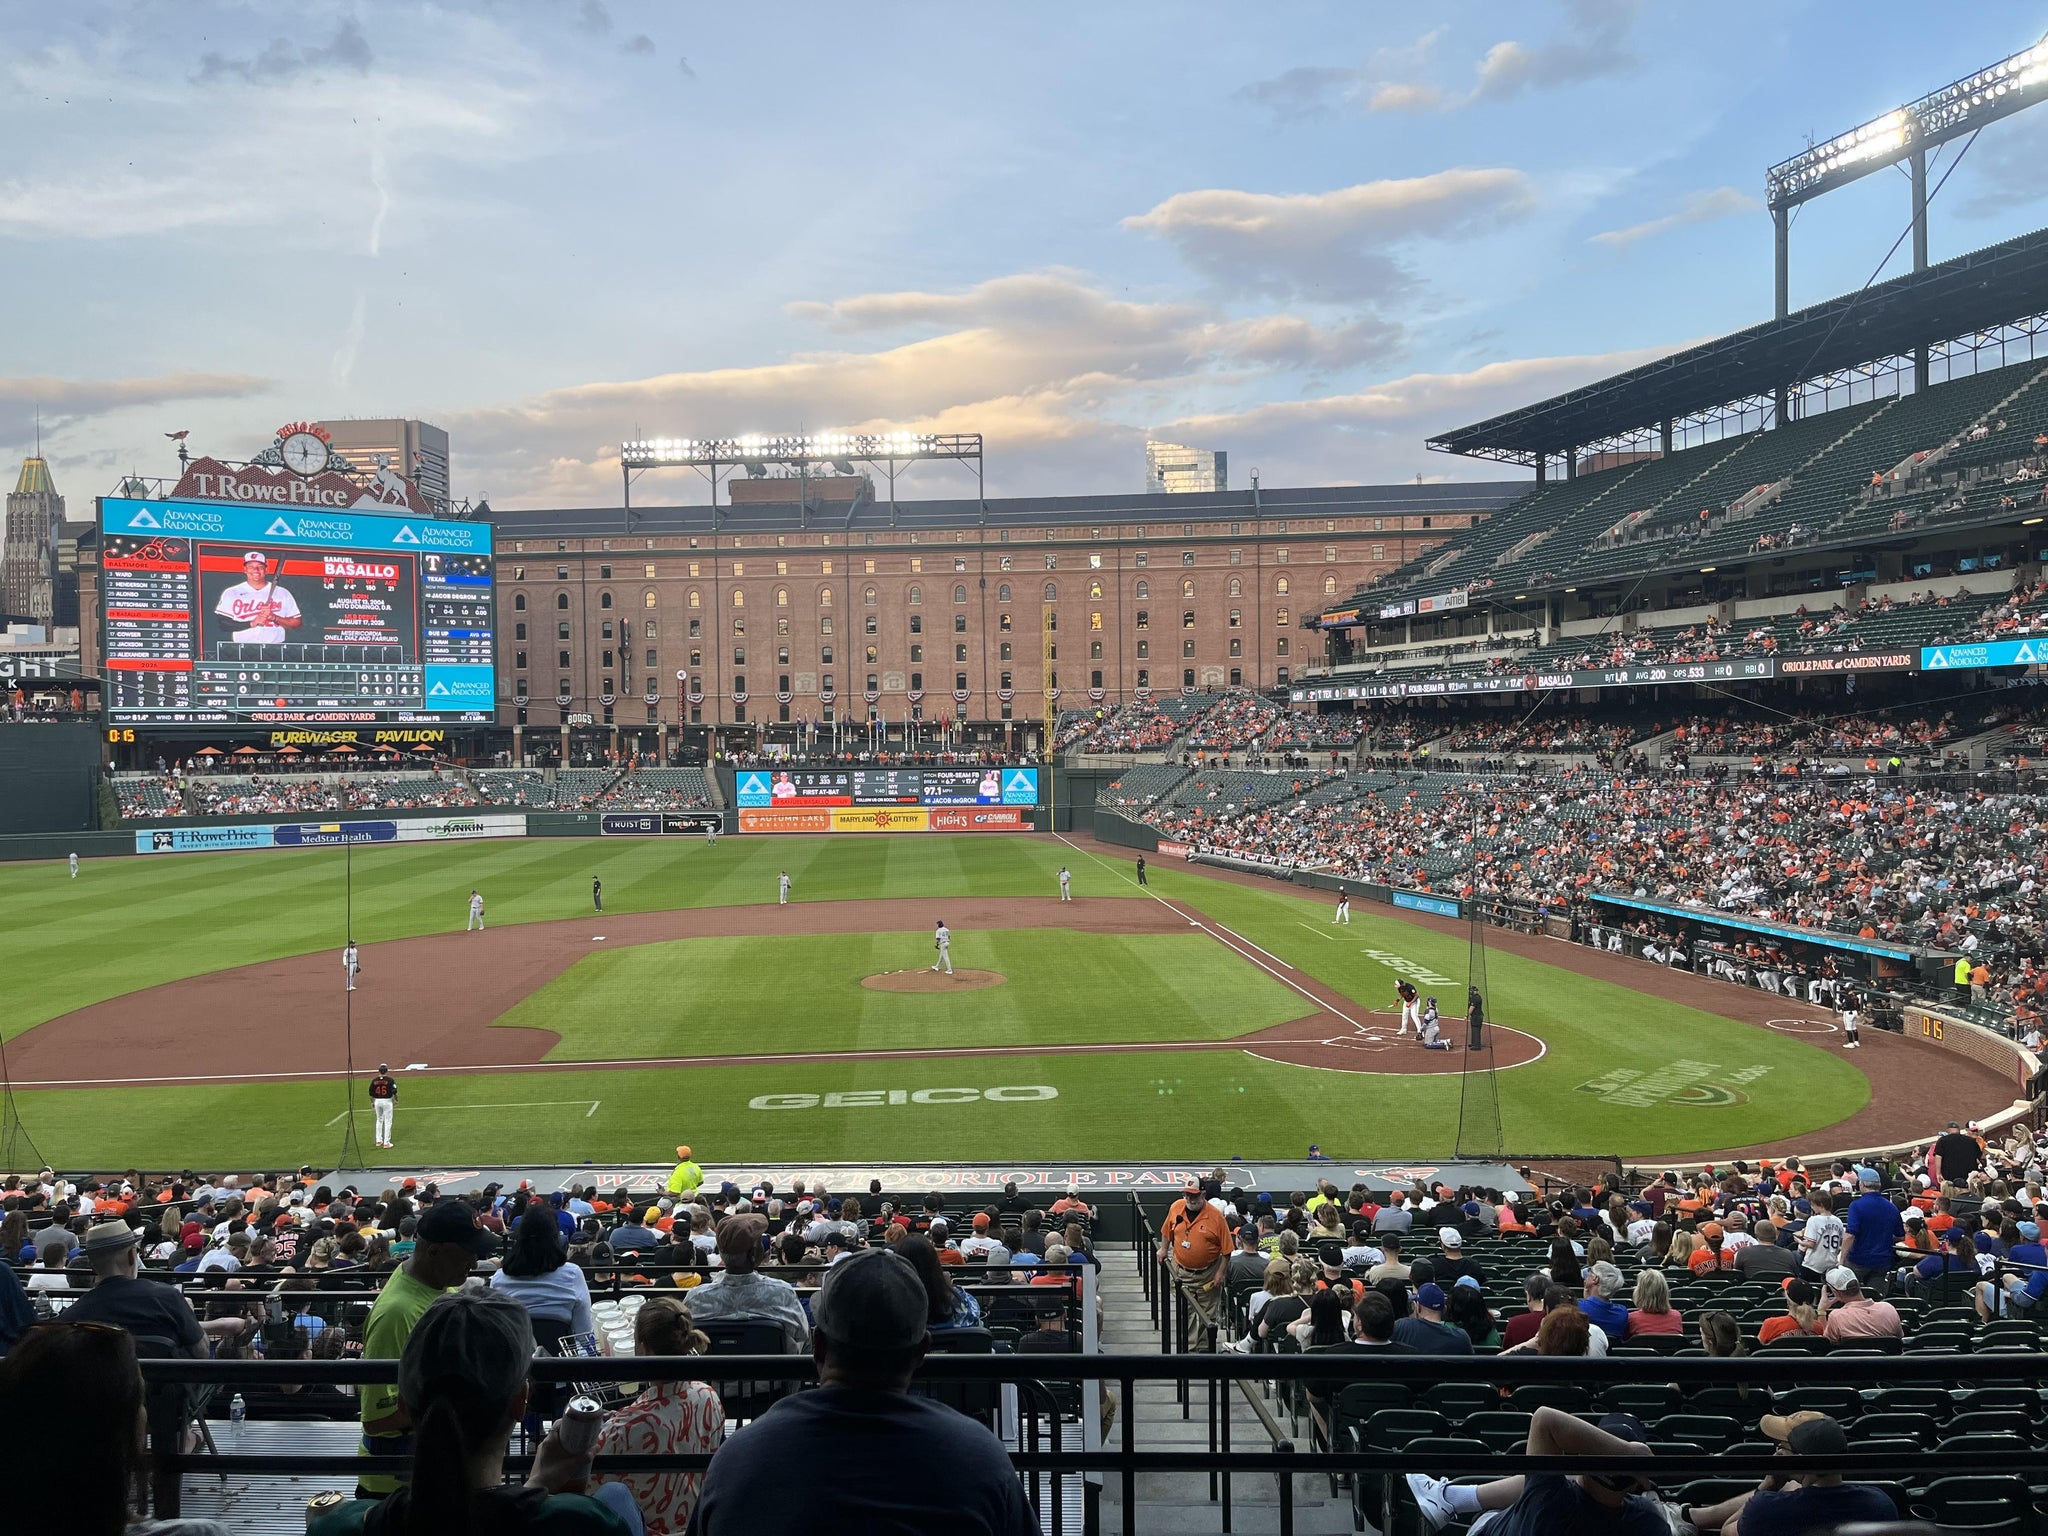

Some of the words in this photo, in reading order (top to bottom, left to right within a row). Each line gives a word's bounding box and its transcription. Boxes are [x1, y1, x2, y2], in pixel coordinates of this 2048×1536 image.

[288, 480, 349, 506] Price
[163, 509, 222, 523] ADVANCED
[163, 518, 225, 532] RADIOLOGY
[298, 517, 351, 531] ADVANCED
[298, 526, 354, 540] RADIOLOGY
[422, 526, 471, 538] ADVANCED
[421, 535, 474, 547] RADIOLOGY
[324, 556, 354, 564] SAMUEL
[325, 563, 395, 578] BASALLO
[1950, 647, 1987, 657] ADVANCED
[1782, 661, 1812, 673] ORIOLE
[1812, 659, 1834, 671] PARK
[1843, 656, 1882, 669] CAMDEN
[1882, 654, 1911, 666] YARDS
[1949, 655, 1988, 666] RADIOLOGY
[239, 672, 247, 681] 0
[252, 672, 260, 681] 0
[361, 673, 368, 682] 0
[374, 673, 379, 682] 1
[385, 674, 392, 682] 0
[400, 674, 407, 682] 4
[412, 674, 419, 682] 2
[1537, 674, 1573, 687] BASALLO
[1605, 672, 1615, 683] B/T
[1615, 671, 1628, 683] L/R
[1635, 670, 1649, 680] AVG
[1649, 669, 1666, 681] .200
[1673, 668, 1687, 678] OPS
[1687, 667, 1705, 679] .533
[1714, 666, 1725, 676] HR
[1725, 665, 1732, 677] 0
[1745, 664, 1757, 674] RBI
[1757, 662, 1765, 675] 0
[8, 679, 17, 689] K
[452, 681, 490, 689] ADVANCED
[1408, 683, 1437, 694] FOUR-SEAM
[1437, 683, 1445, 692] FB
[239, 685, 247, 694] 0
[361, 686, 368, 695] 0
[374, 686, 380, 695] 1
[385, 686, 393, 695] 0
[400, 687, 407, 695] 4
[412, 687, 419, 695] 2
[451, 688, 491, 696] RADIOLOGY
[1323, 689, 1333, 698] TEX
[1347, 688, 1359, 697] BAL
[251, 713, 283, 721] ORIOLE
[284, 713, 305, 721] PARK
[314, 713, 350, 721] CAMDEN
[350, 713, 376, 721] YARDS
[109, 729, 135, 742] 0:15
[270, 730, 358, 744] PUREWAGER
[375, 729, 445, 743] PAVILION
[923, 786, 942, 796] 97.1
[760, 814, 799, 822] AUTUMN
[802, 814, 825, 822] LAKE
[890, 815, 919, 823] LOTTERY
[937, 816, 968, 827] HIGH'S
[227, 829, 258, 840] Price
[301, 834, 339, 844] MedStar
[340, 832, 372, 842] Health
[748, 1085, 1060, 1110] GEICO
[594, 1173, 835, 1187] WECOME
[838, 1172, 909, 1187] TO
[915, 1170, 1099, 1187] ORIOLE
[1823, 1234, 1839, 1249] 36
